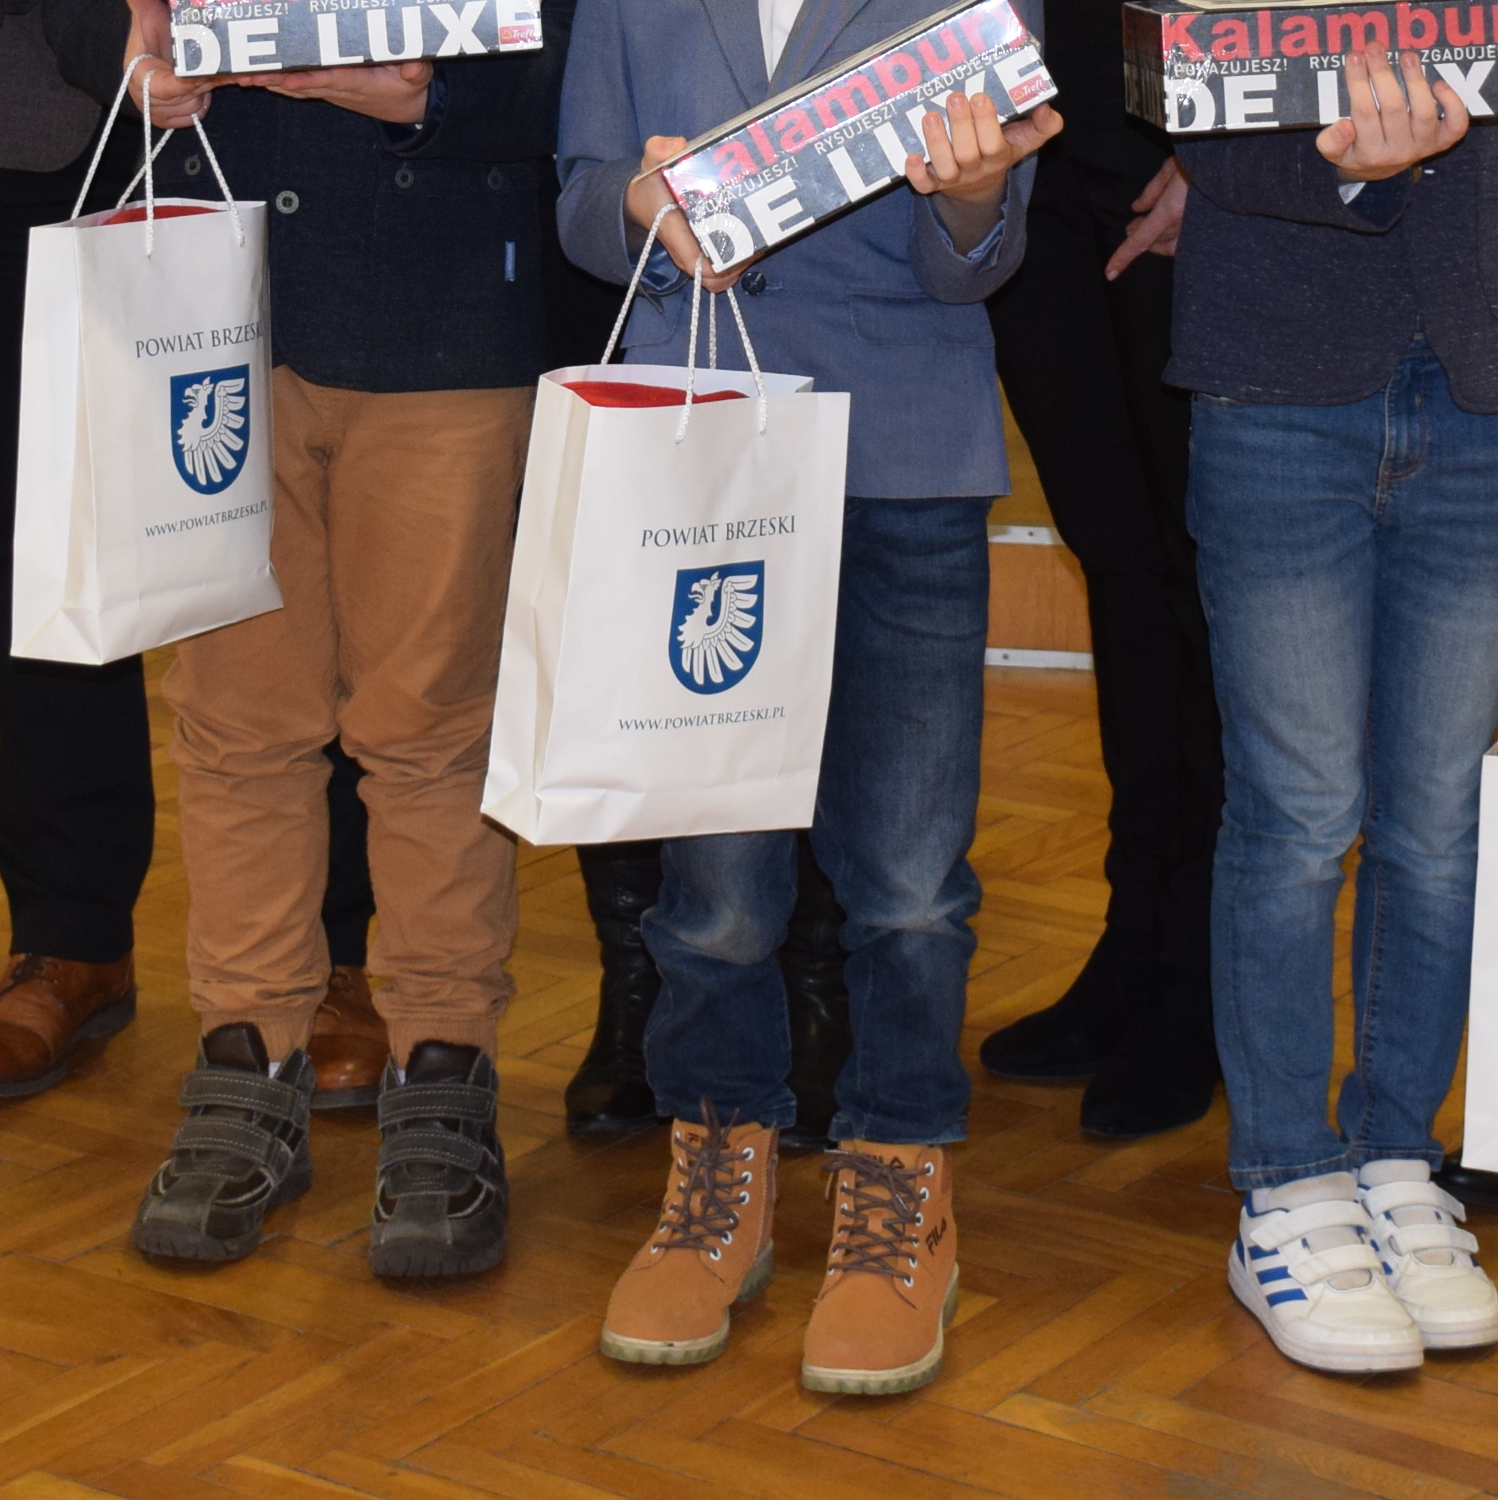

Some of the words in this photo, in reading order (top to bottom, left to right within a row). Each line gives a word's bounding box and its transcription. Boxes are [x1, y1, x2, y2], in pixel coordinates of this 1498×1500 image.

[171, 17, 283, 77] DE
[511, 28, 535, 40] Trefl
[1174, 57, 1288, 78] POKAZUJESZ!
[1310, 51, 1400, 69] RYSZ!
[814, 102, 898, 156] RYSUJESZ!
[913, 44, 1006, 103] ZGADUJESZ!
[1022, 79, 1044, 95] Trefl
[1163, 73, 1280, 133] DE
[689, 175, 816, 274] DE
[135, 332, 205, 358] POWIAT
[211, 320, 264, 348] BRZESK
[145, 500, 269, 538] WWW.POWIATBRZESKI.PL
[641, 523, 719, 548] POWIAT
[726, 515, 796, 541] BRZESKI
[618, 706, 786, 730] WWW.POWIATBRZESKI.PL
